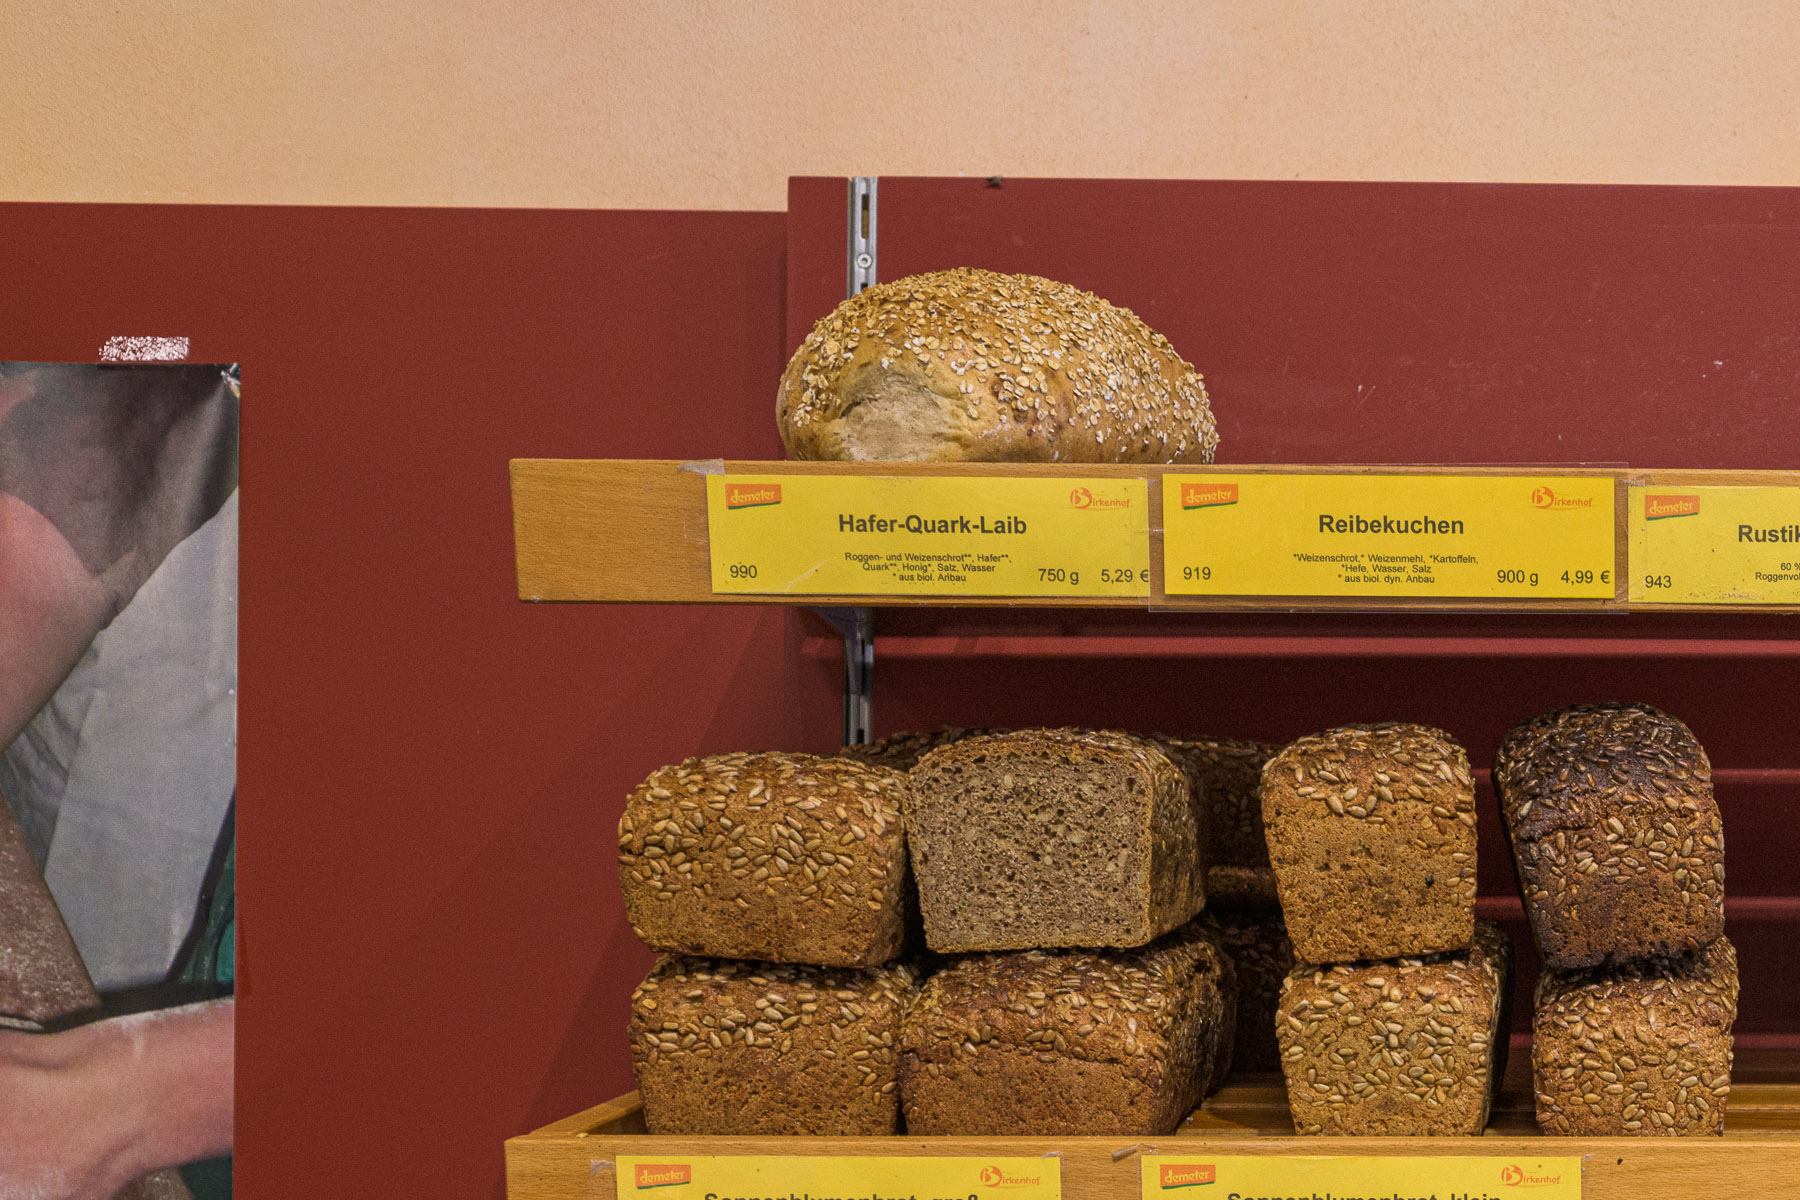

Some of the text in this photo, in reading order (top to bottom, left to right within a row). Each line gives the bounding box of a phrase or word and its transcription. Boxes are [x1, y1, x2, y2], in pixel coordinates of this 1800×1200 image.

[839, 514, 1027, 534] Hafer-Quark-Laib
[1319, 515, 1464, 534] Reibekuchen
[730, 562, 757, 578] 990
[1038, 568, 1079, 585] 750 g
[1101, 569, 1150, 584] 5,29 €
[1183, 567, 1211, 580] 919
[1497, 570, 1538, 586] 900 g
[1561, 570, 1610, 585] 4,99 €
[1645, 575, 1672, 588] 943
